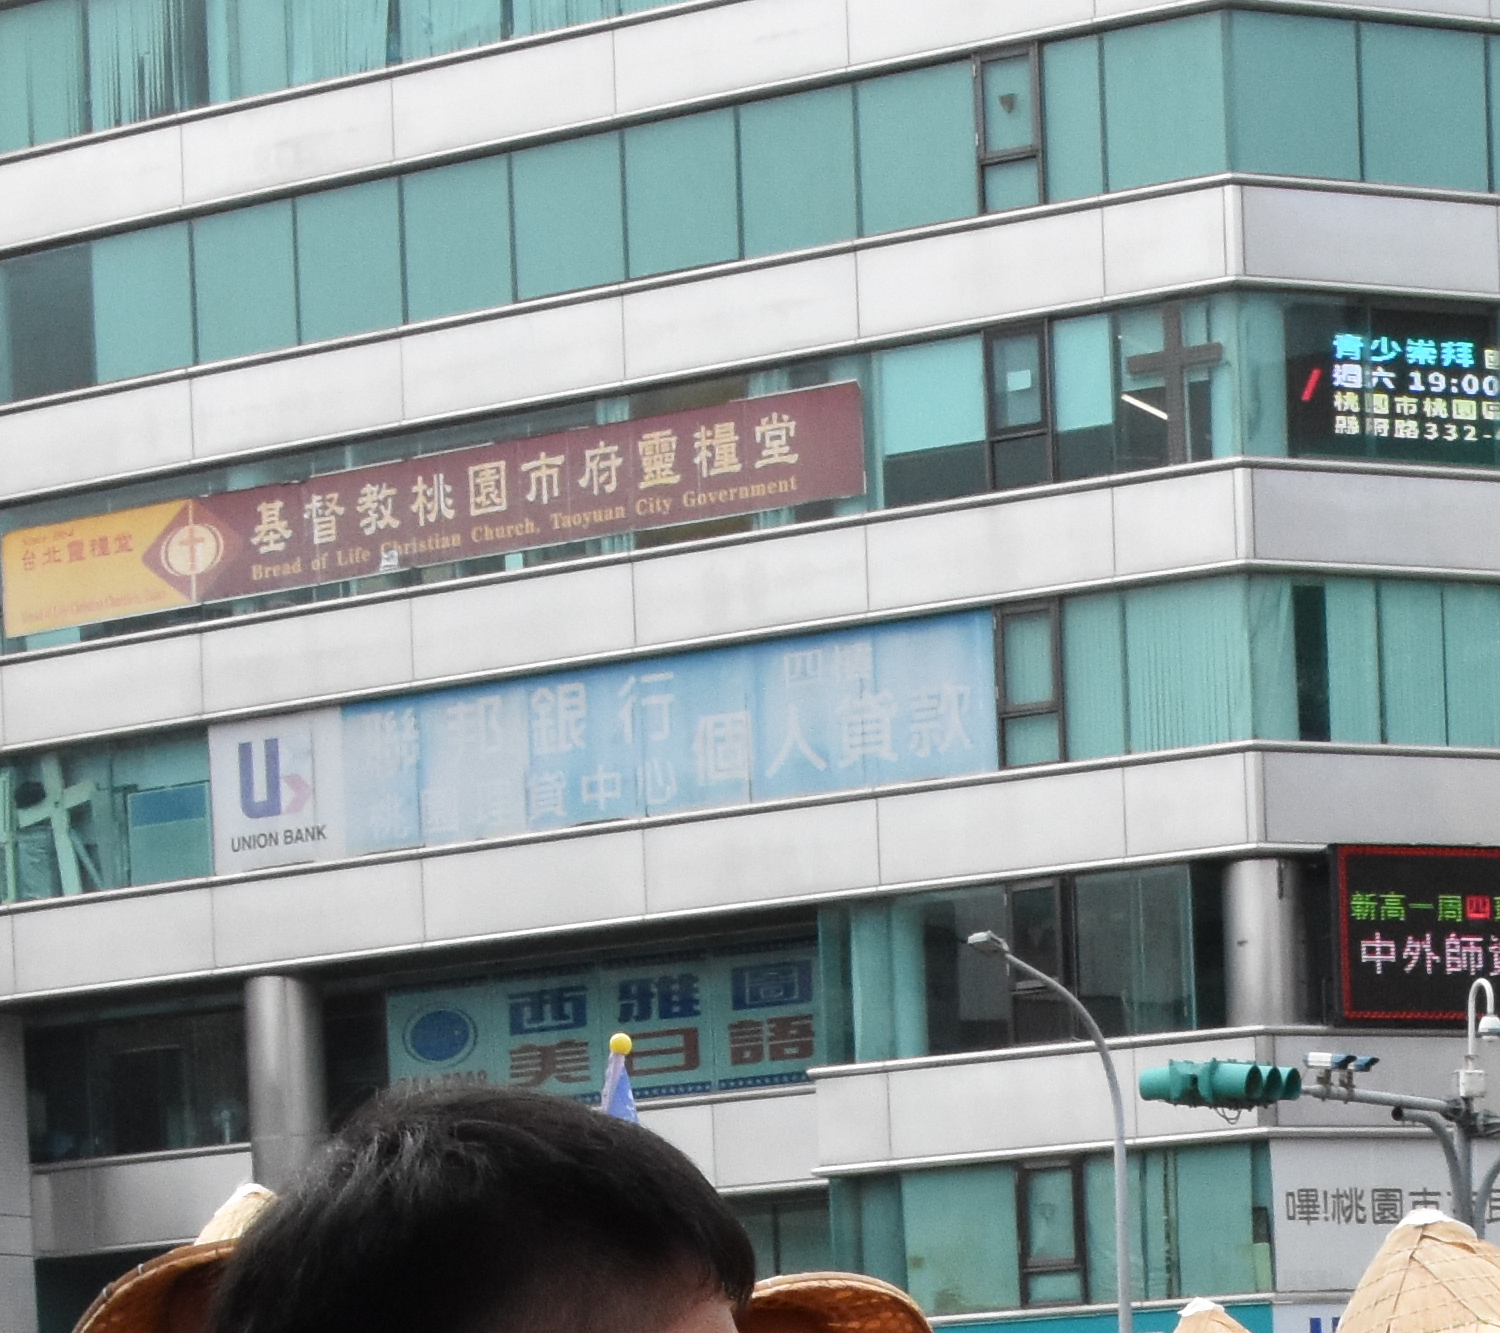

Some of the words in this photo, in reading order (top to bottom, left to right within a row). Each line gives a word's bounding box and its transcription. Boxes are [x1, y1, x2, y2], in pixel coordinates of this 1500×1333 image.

[1333, 334, 1475, 368] 青少崇拜
[251, 411, 800, 555] 基督教桃園市府靈糧堂
[251, 561, 302, 582] Bread
[310, 555, 329, 571] of
[335, 547, 372, 567] Life
[380, 531, 463, 562] Christian
[549, 507, 628, 536] Taoyuan
[635, 494, 675, 519] City
[682, 475, 798, 511] Government
[231, 831, 280, 853] UNION
[283, 824, 327, 847] BANK
[508, 1012, 815, 1088] 美日語
